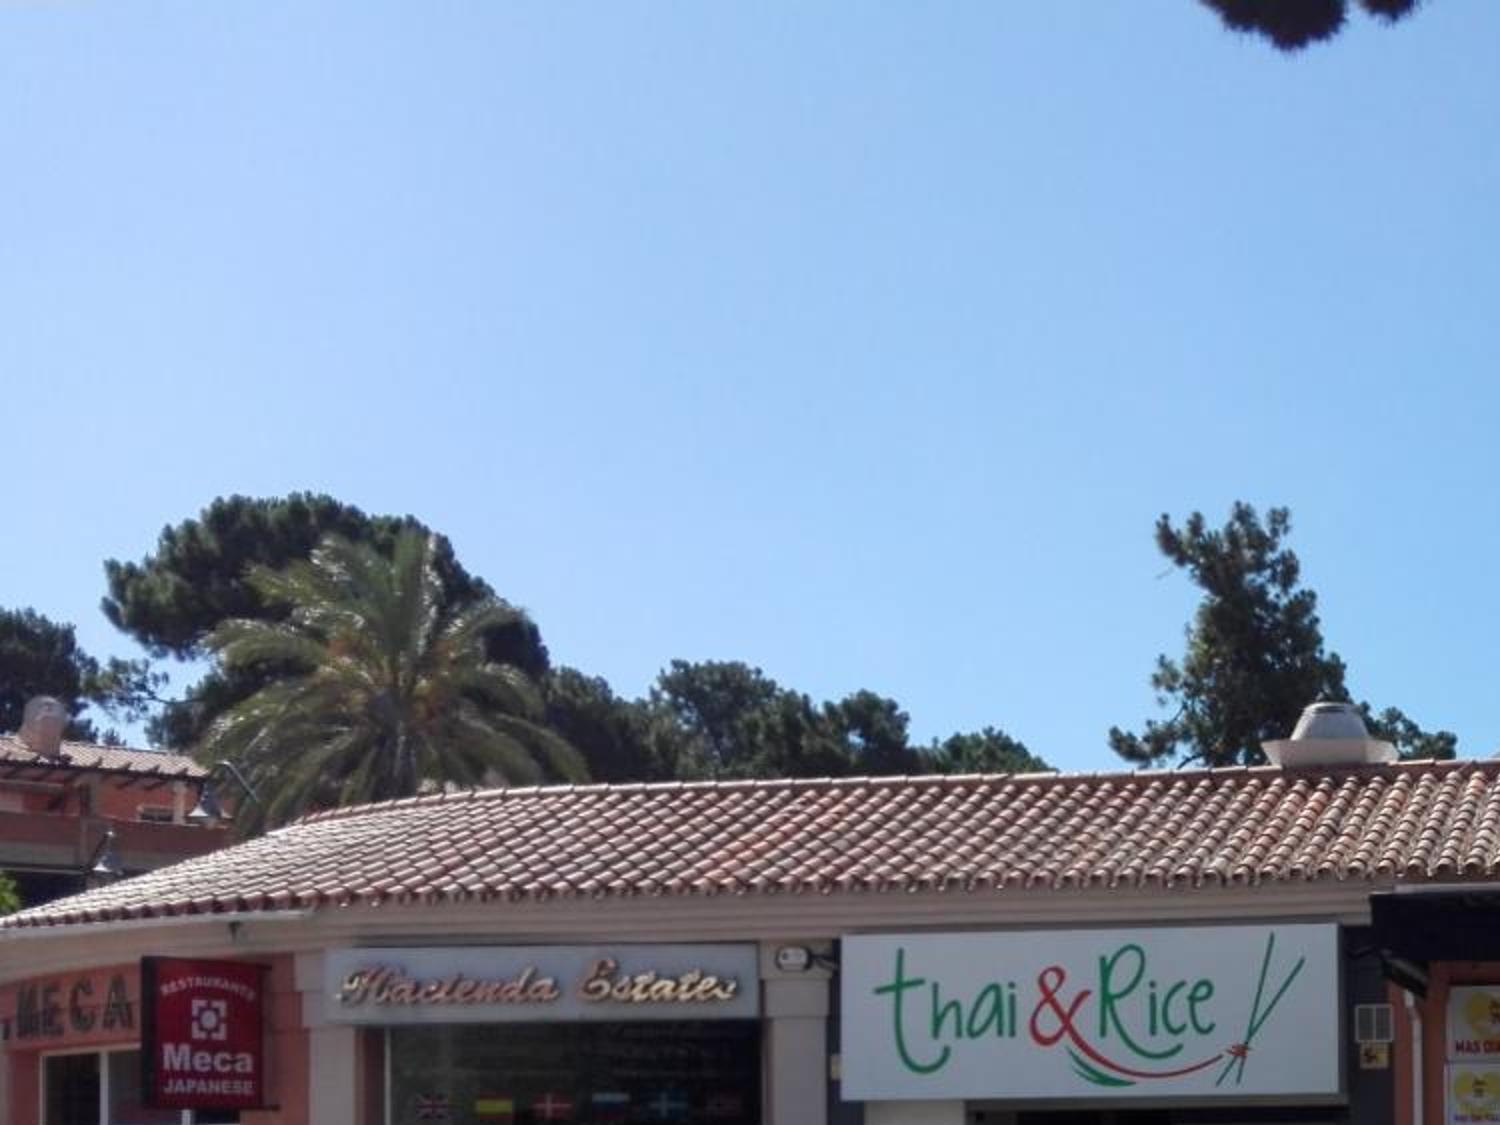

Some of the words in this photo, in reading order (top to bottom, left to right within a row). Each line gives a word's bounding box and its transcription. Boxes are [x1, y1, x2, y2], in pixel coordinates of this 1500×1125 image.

[335, 961, 560, 1006] Hacienda
[16, 973, 135, 1040] MECA
[162, 1042, 254, 1073] Meca
[164, 1078, 255, 1097] JAPANESE
